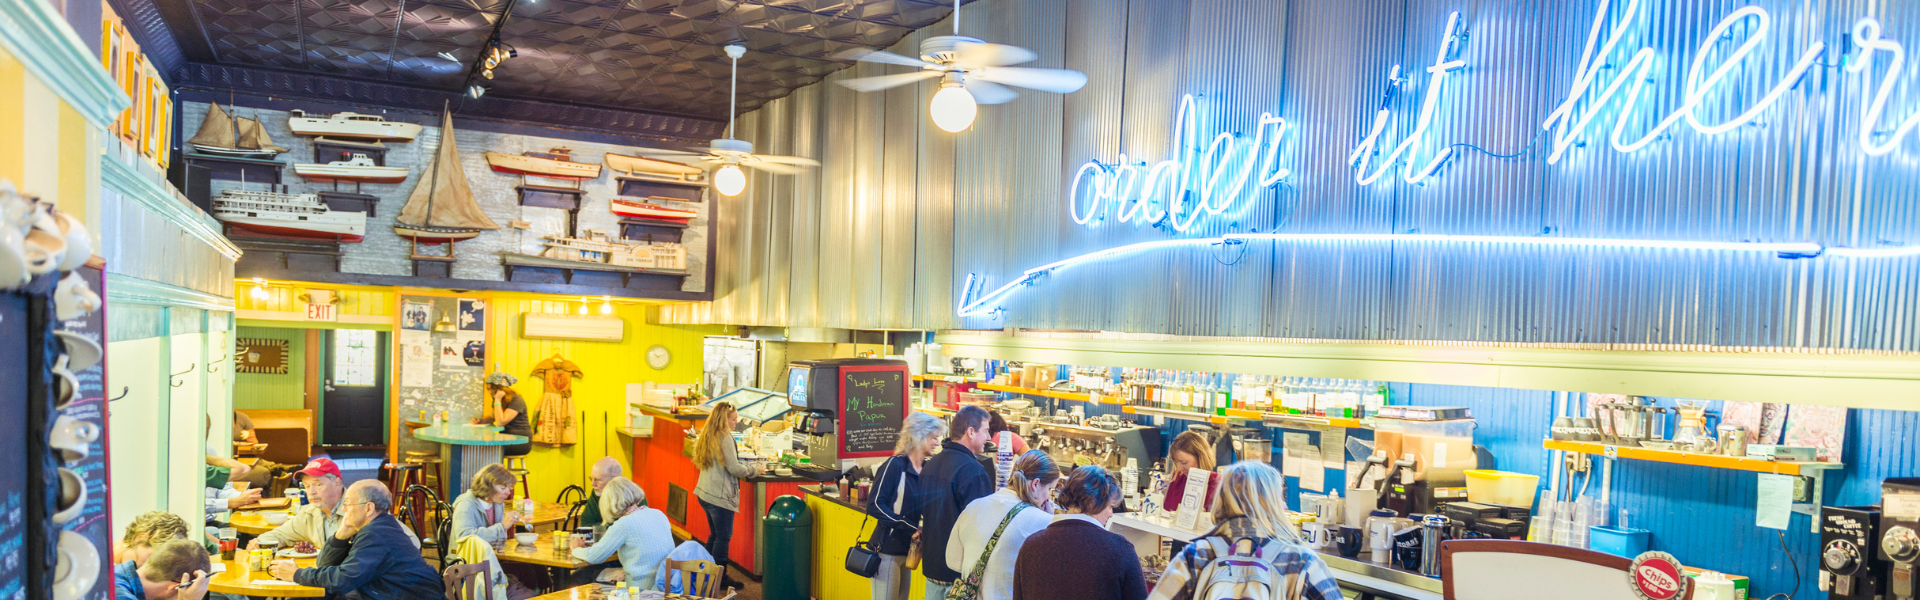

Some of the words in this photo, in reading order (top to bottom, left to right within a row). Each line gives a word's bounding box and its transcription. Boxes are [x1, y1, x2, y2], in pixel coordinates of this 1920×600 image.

[1070, 92, 1290, 232] order
[1347, 10, 1467, 187] it
[308, 304, 332, 320] EXIT
[1645, 568, 1672, 589] chips
